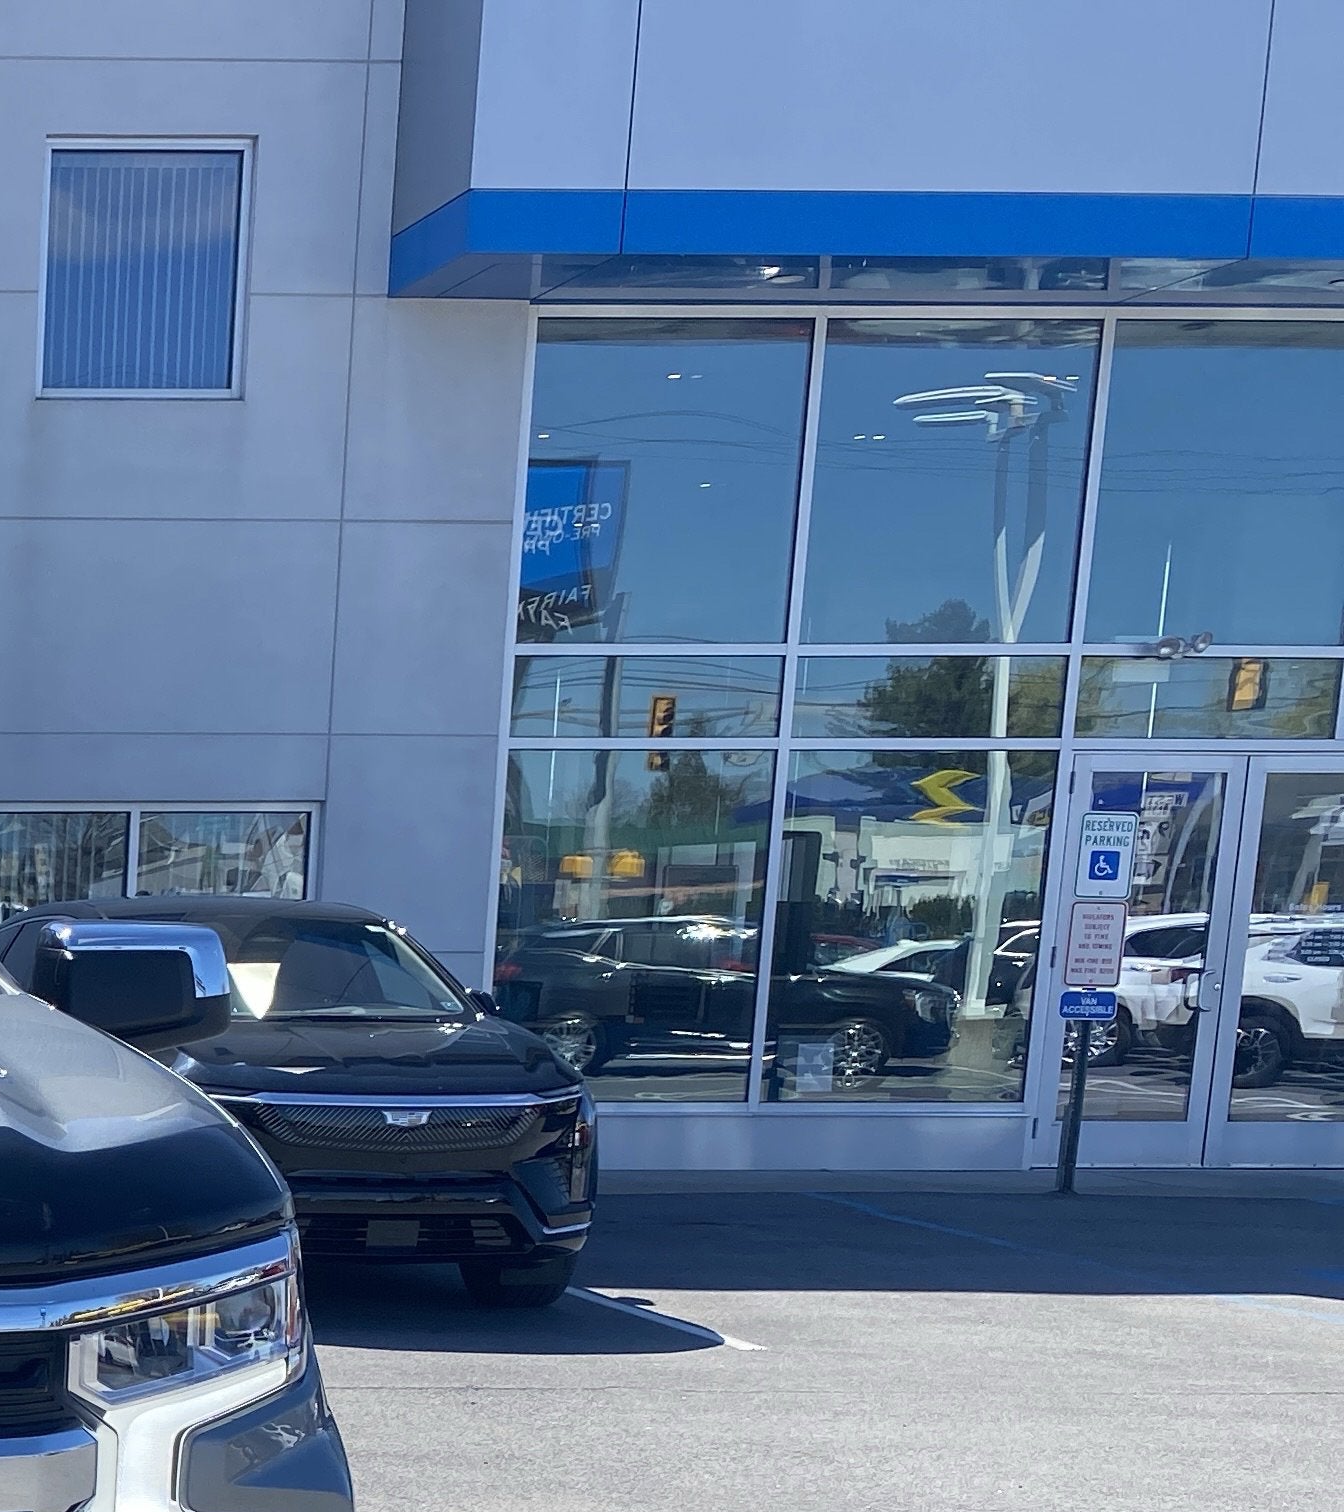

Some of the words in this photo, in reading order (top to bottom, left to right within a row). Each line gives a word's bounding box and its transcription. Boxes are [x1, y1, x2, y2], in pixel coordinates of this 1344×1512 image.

[1084, 819, 1133, 832] RESERVED
[1084, 834, 1130, 847] PARKING
[1081, 997, 1098, 1006] VAN
[1062, 1005, 1113, 1014] ACCESSIBLE
